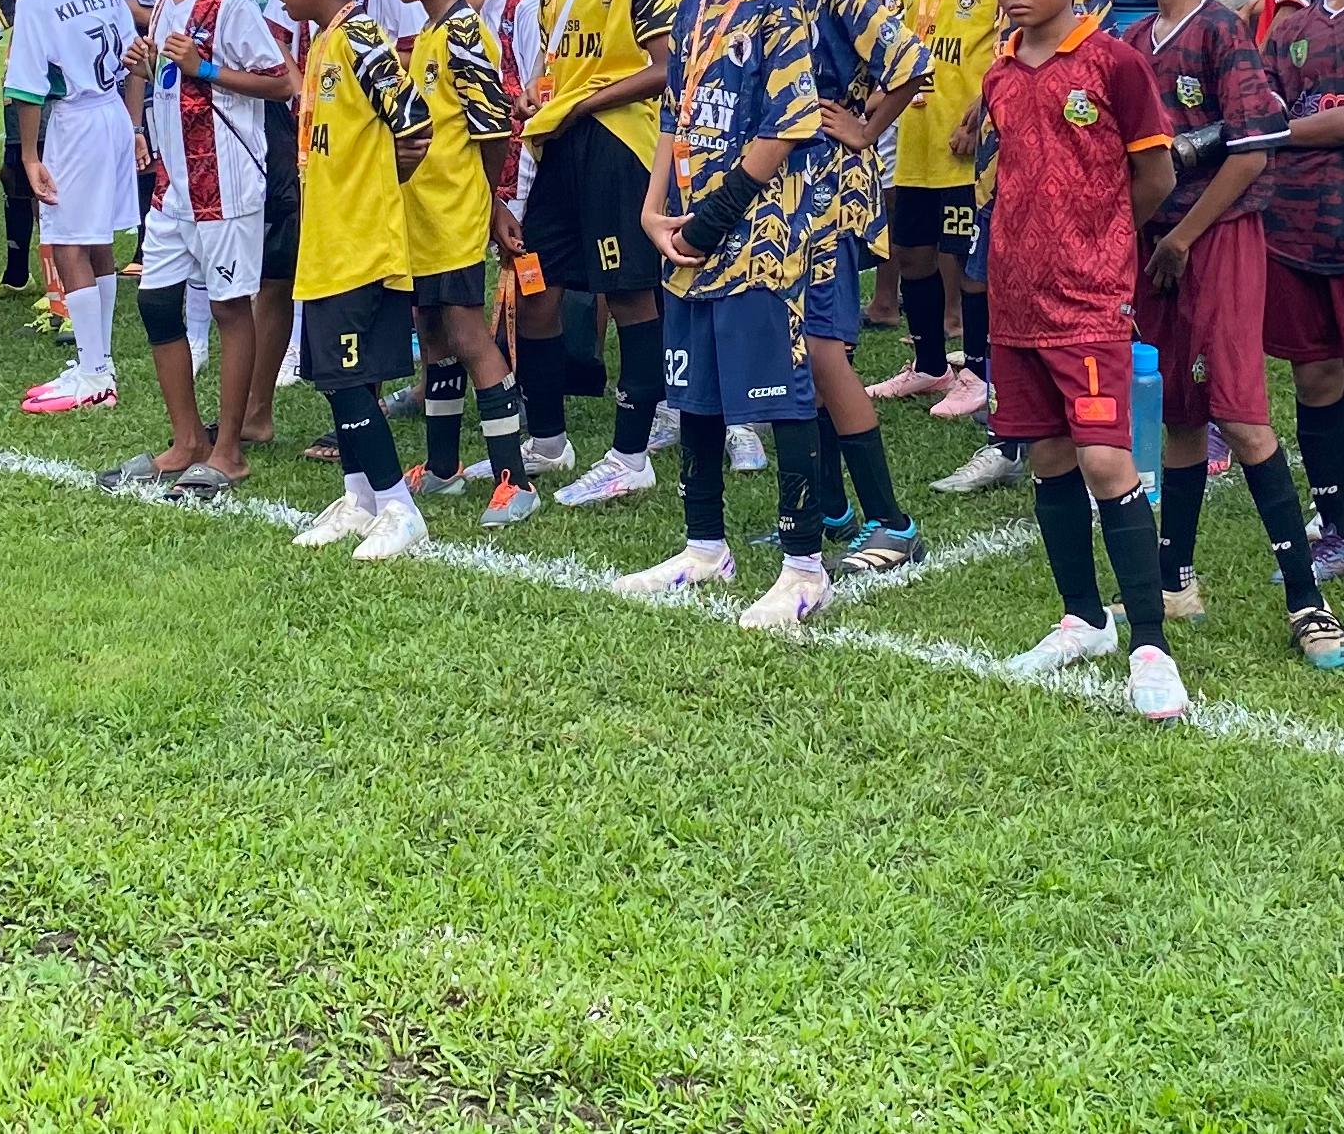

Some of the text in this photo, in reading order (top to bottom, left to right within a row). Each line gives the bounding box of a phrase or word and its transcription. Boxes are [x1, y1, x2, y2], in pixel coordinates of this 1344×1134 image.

[943, 206, 973, 235] 22
[597, 236, 620, 271] 19
[340, 333, 358, 368] 3
[665, 348, 688, 387] 32
[1084, 356, 1099, 396] 1
